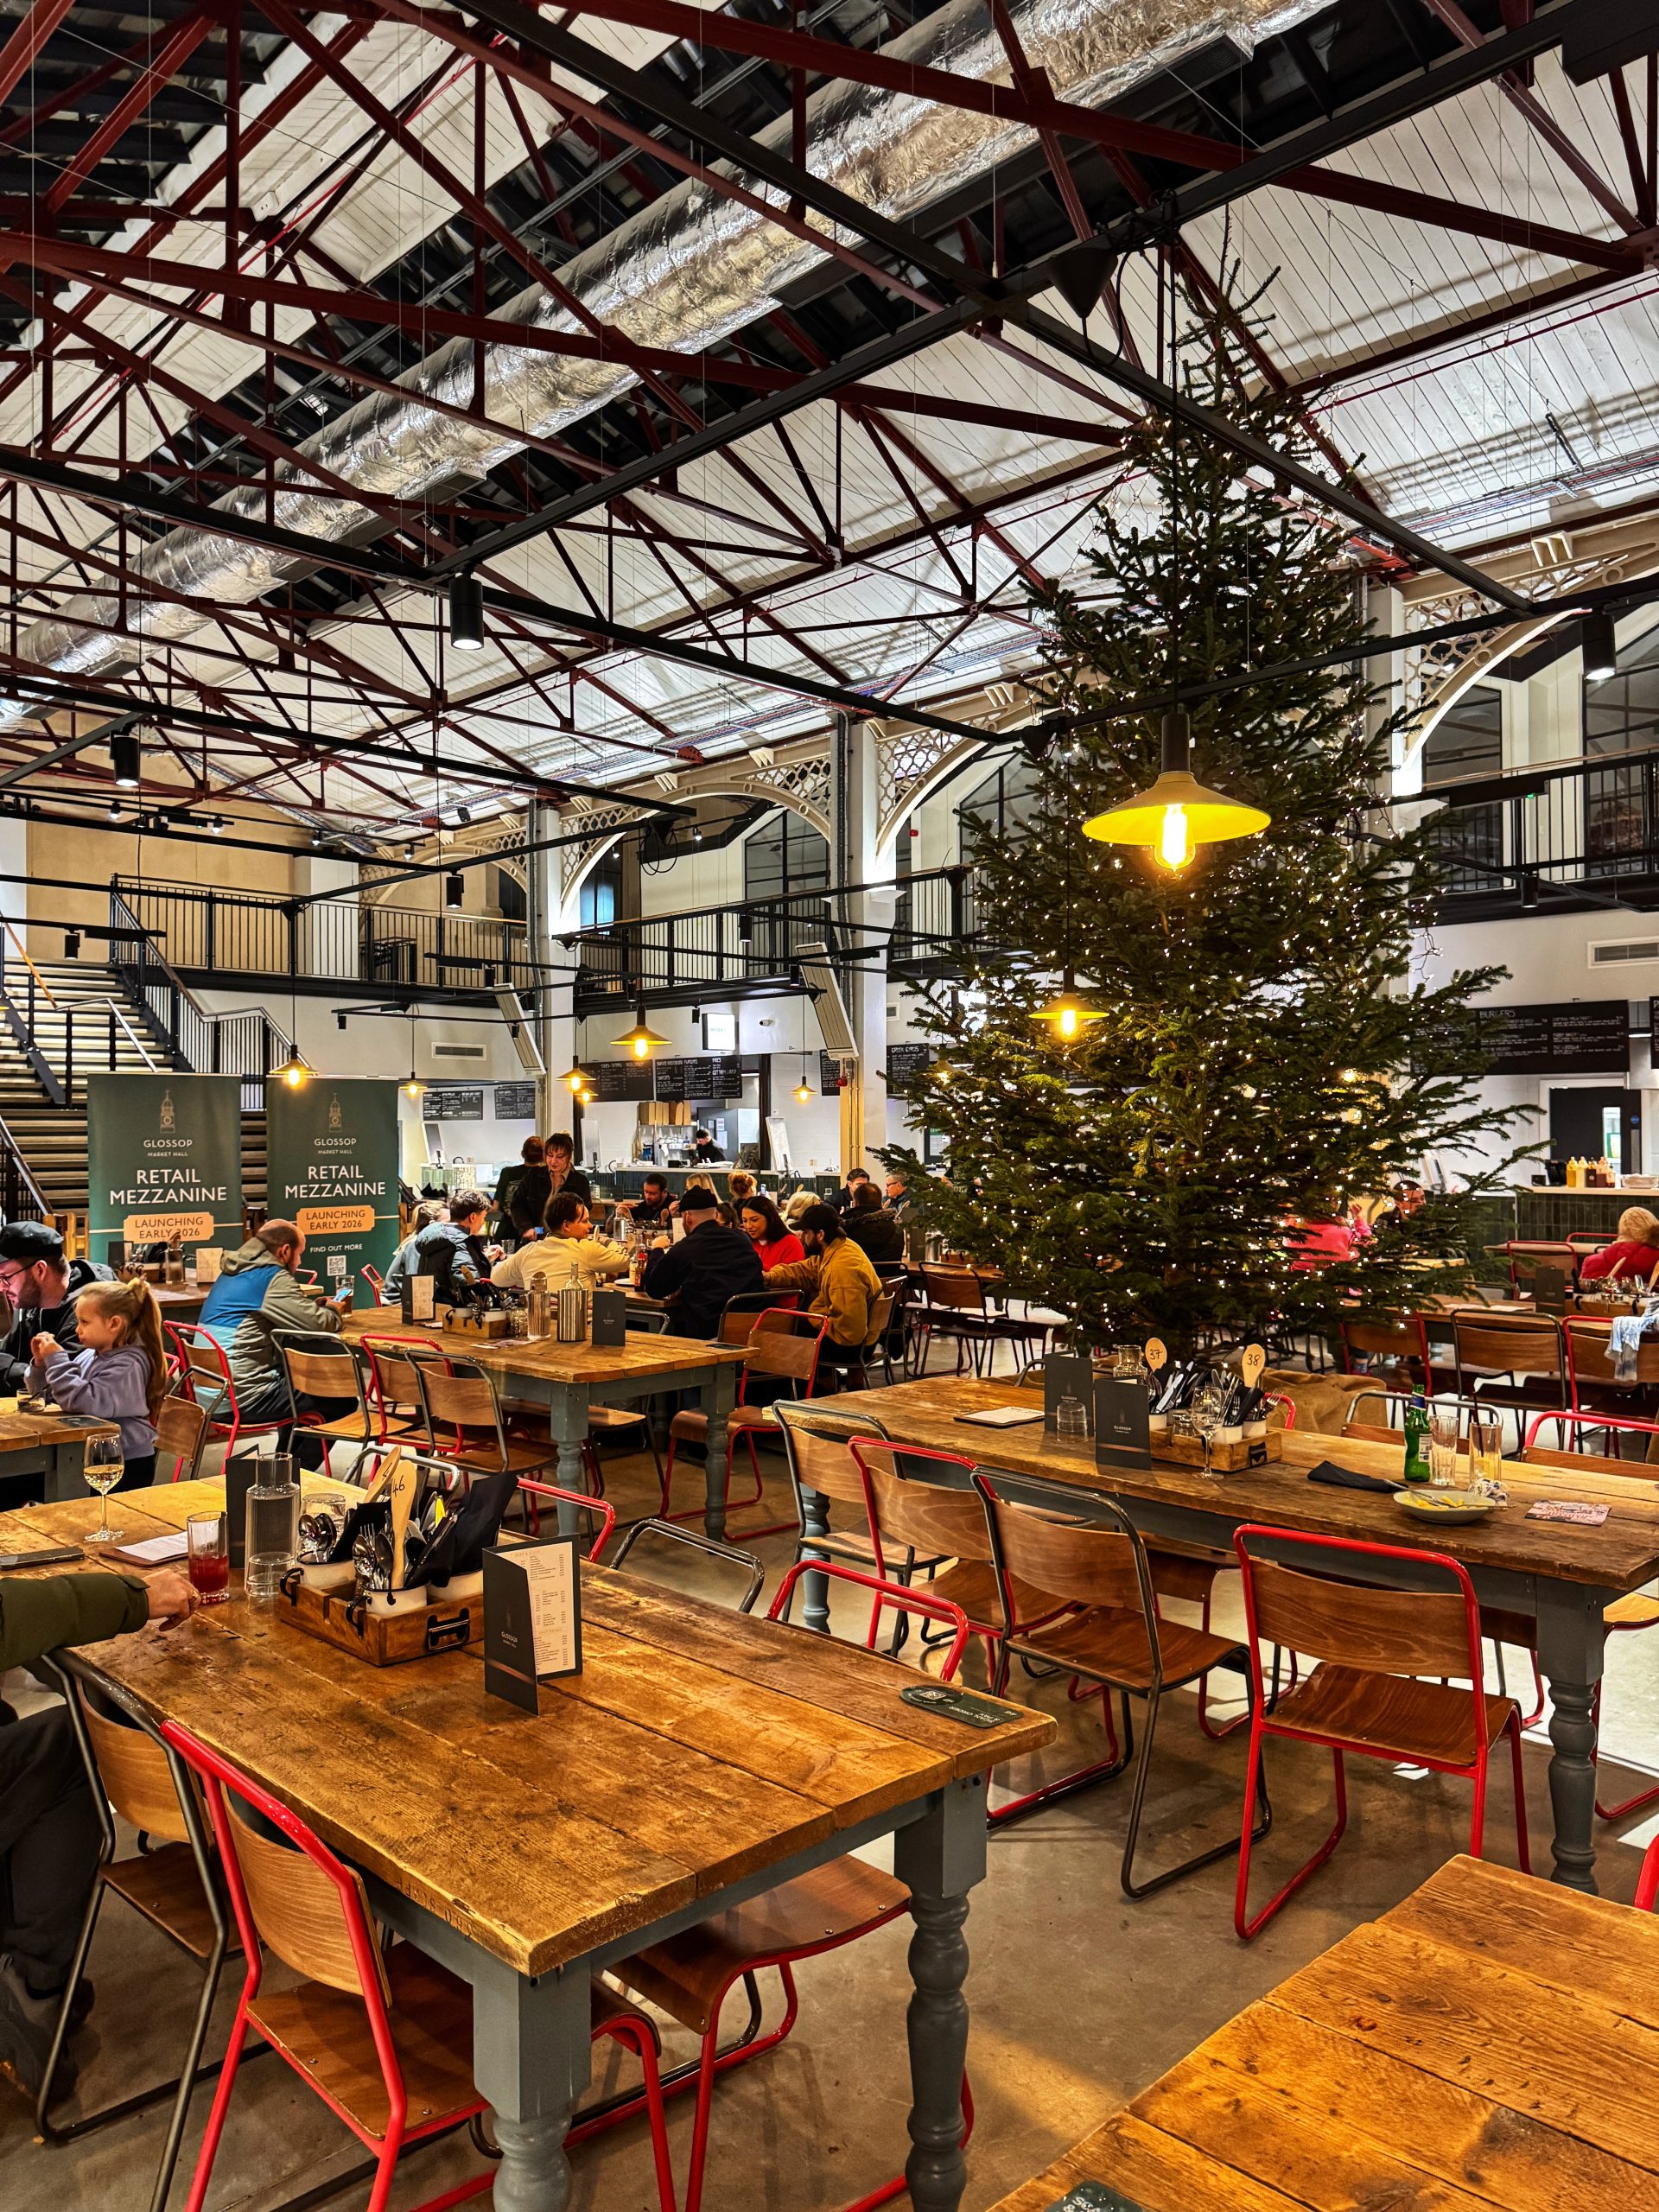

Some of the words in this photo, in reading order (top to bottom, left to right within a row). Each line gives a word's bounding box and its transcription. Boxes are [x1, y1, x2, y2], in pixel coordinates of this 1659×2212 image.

[143, 1139, 193, 1148] GLOSSOP
[314, 1138, 357, 1147] GLOSSOP
[137, 1168, 200, 1185] RETAIL
[308, 1165, 364, 1180] RETAIL
[110, 1186, 227, 1205] MEZZANINE
[285, 1182, 386, 1199] MEZZANINE
[306, 1210, 365, 1221] LAUNCHING
[135, 1217, 204, 1229] LAUNCHING
[309, 1221, 339, 1230] EARLY
[342, 1220, 363, 1229] 2026
[139, 1230, 173, 1239] EARLY
[1149, 1349, 1163, 1360] 37
[1247, 1353, 1261, 1366] 38
[392, 1474, 405, 1498] 46
